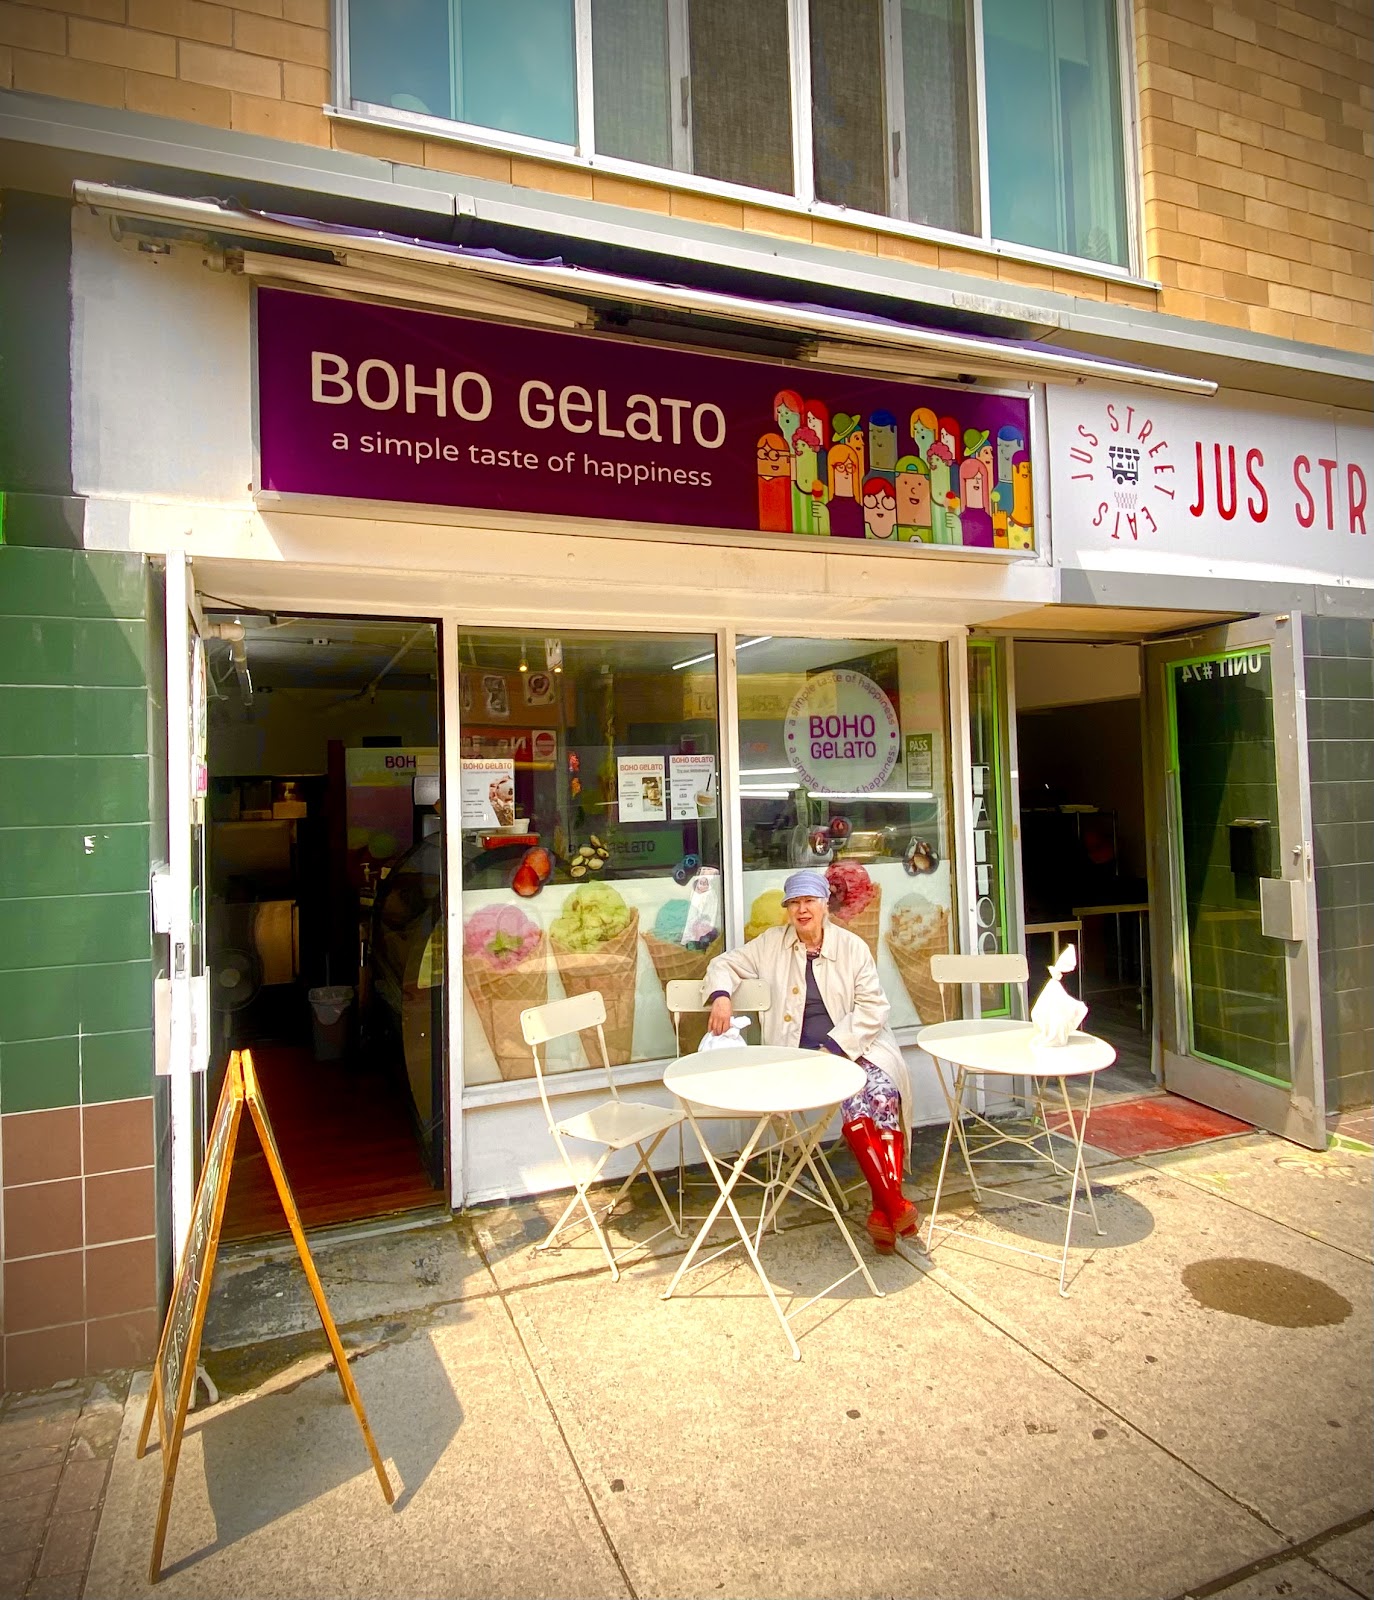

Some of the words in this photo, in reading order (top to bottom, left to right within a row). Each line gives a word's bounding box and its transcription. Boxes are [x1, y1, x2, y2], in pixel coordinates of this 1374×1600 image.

[310, 350, 492, 422] BOHO
[332, 432, 349, 451] a
[360, 431, 459, 464] simple
[468, 444, 539, 470] taste
[547, 449, 575, 473] of
[583, 454, 713, 487] happiness
[1070, 424, 1098, 481] JUS
[1107, 404, 1175, 500] STREET
[1189, 441, 1268, 523] JUS
[1293, 454, 1367, 535] STR
[1093, 502, 1157, 540] EATS
[791, 684, 816, 717] simple
[817, 674, 842, 687] taste
[845, 673, 856, 683] of
[858, 675, 895, 726] happiness
[809, 714, 876, 739] BOHO
[910, 739, 928, 751] PASS
[463, 762, 484, 770] BOHO
[792, 757, 819, 789] simple
[861, 745, 896, 793] happiness
